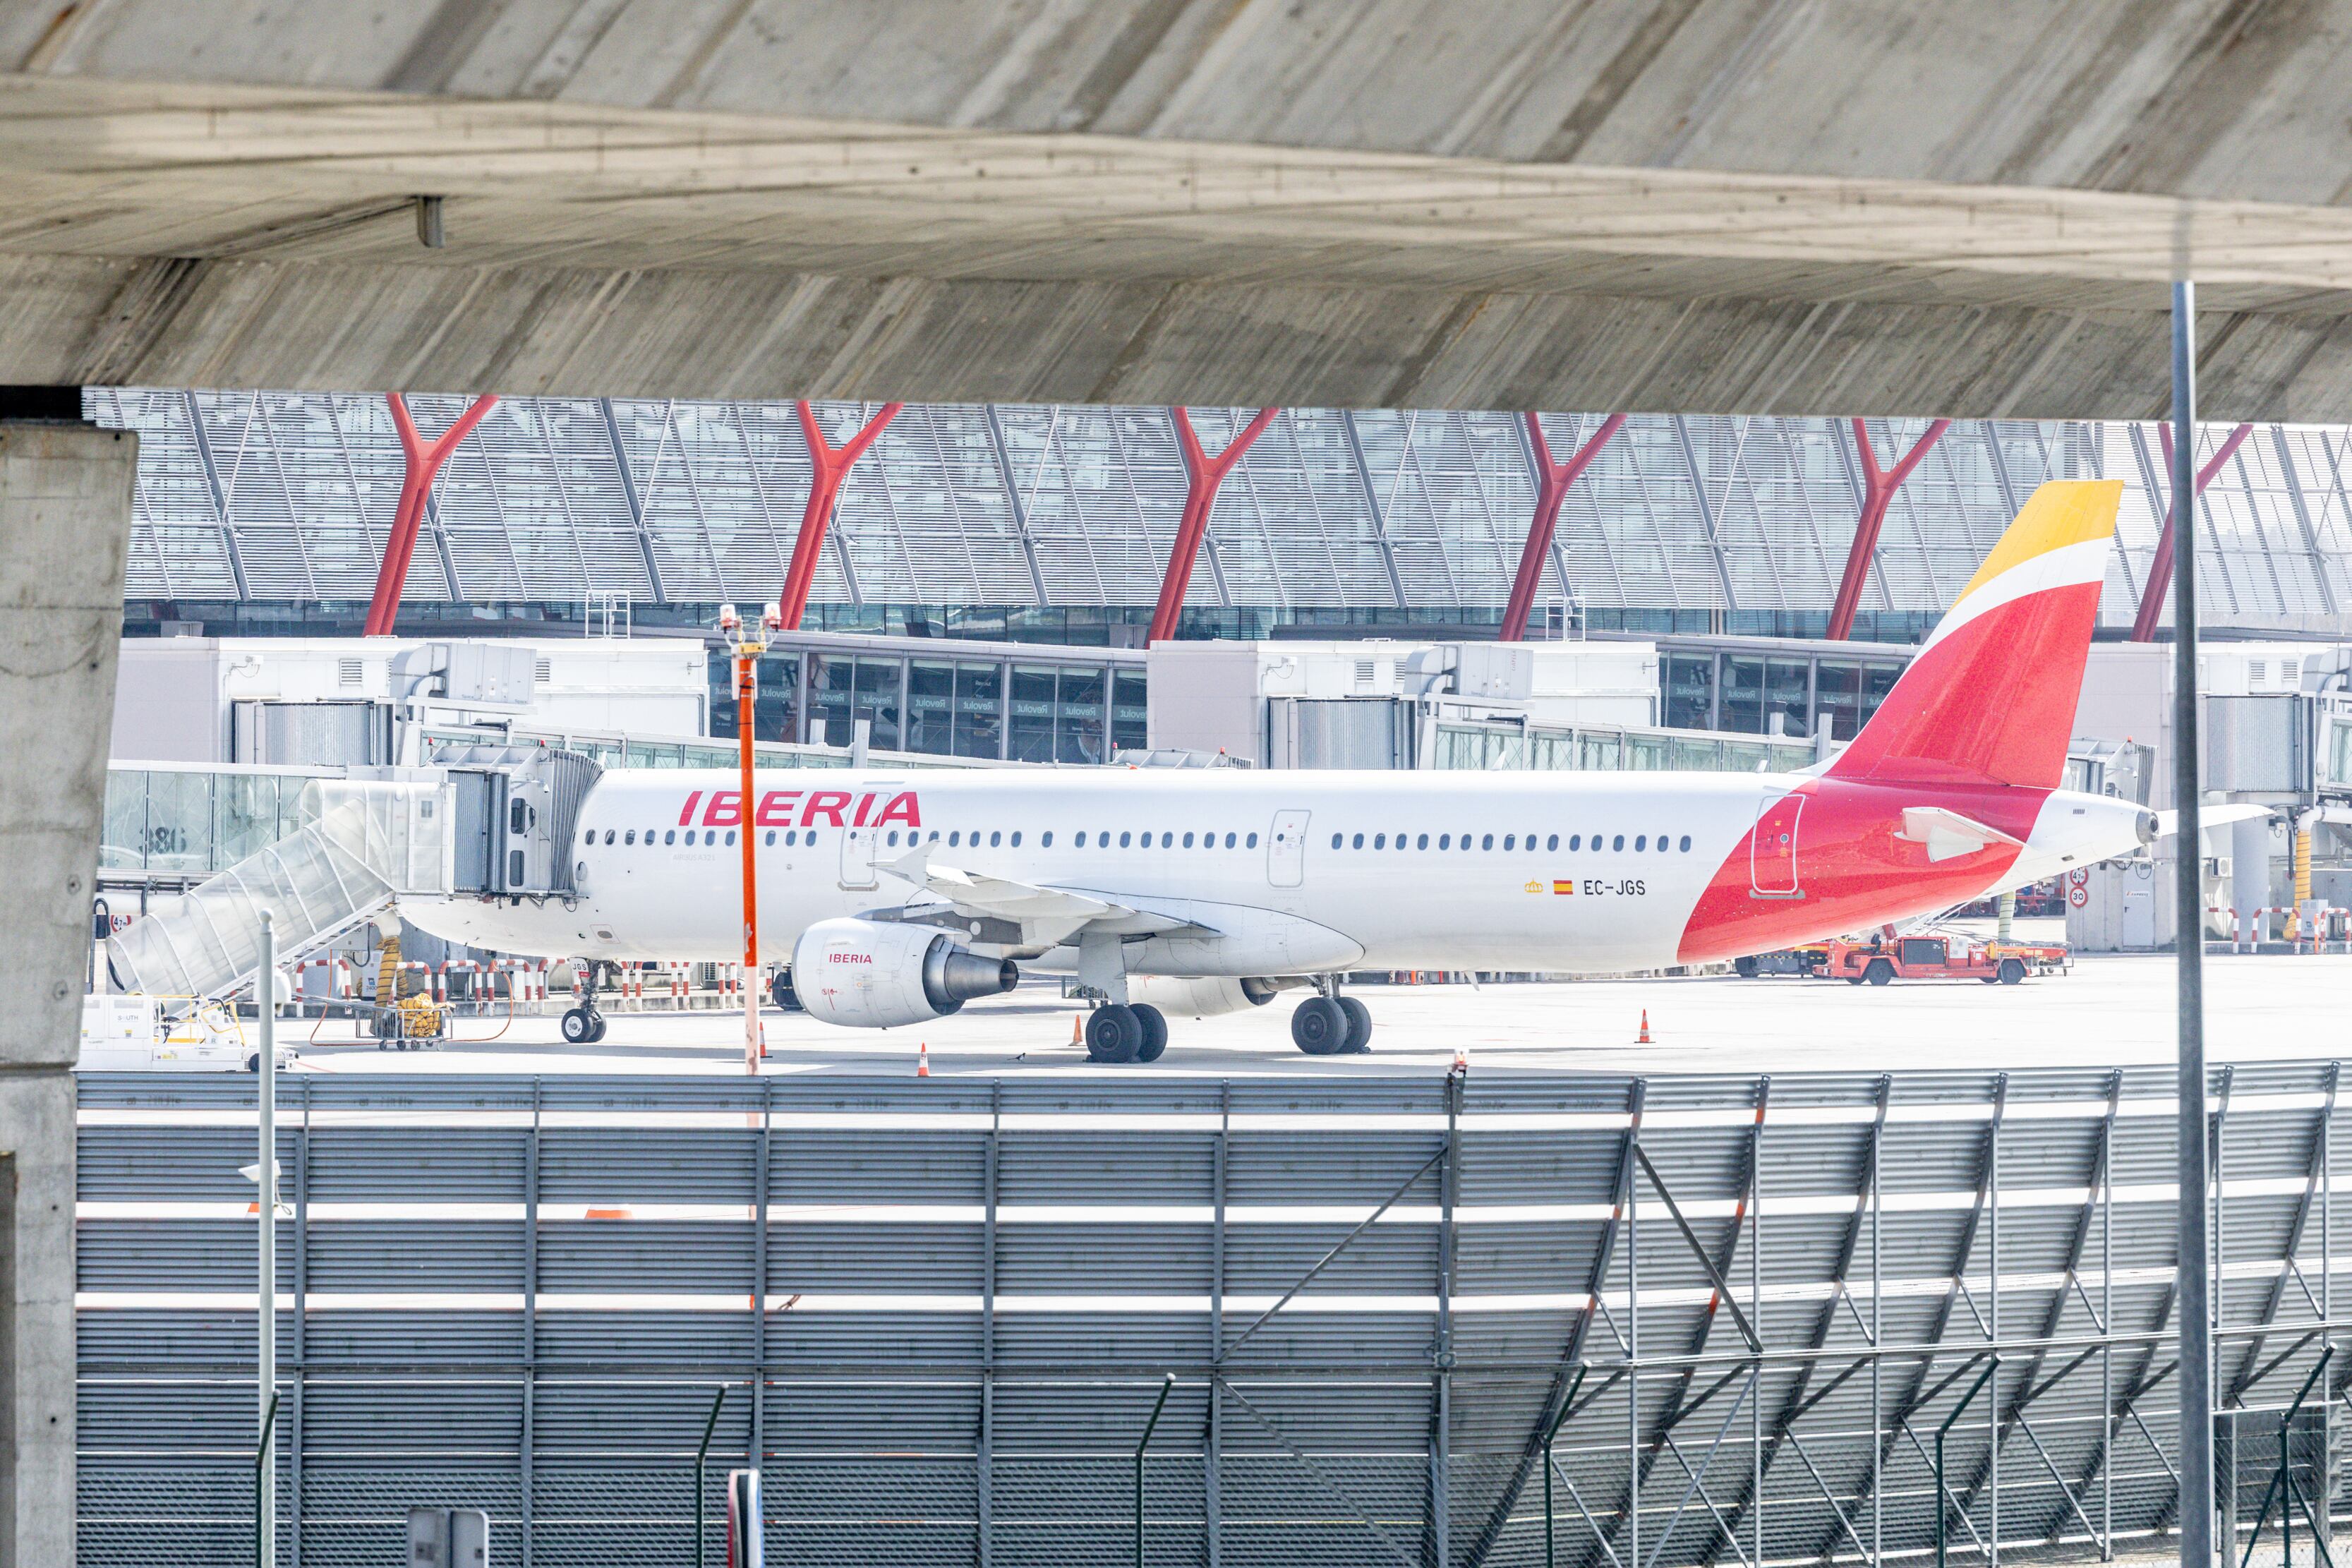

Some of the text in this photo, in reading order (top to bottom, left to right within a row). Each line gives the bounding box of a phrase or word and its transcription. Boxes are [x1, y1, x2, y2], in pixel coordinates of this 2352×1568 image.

[678, 790, 921, 827] IBERIA
[1584, 880, 1646, 895] EC-JGS
[829, 953, 872, 963] IBERIA
